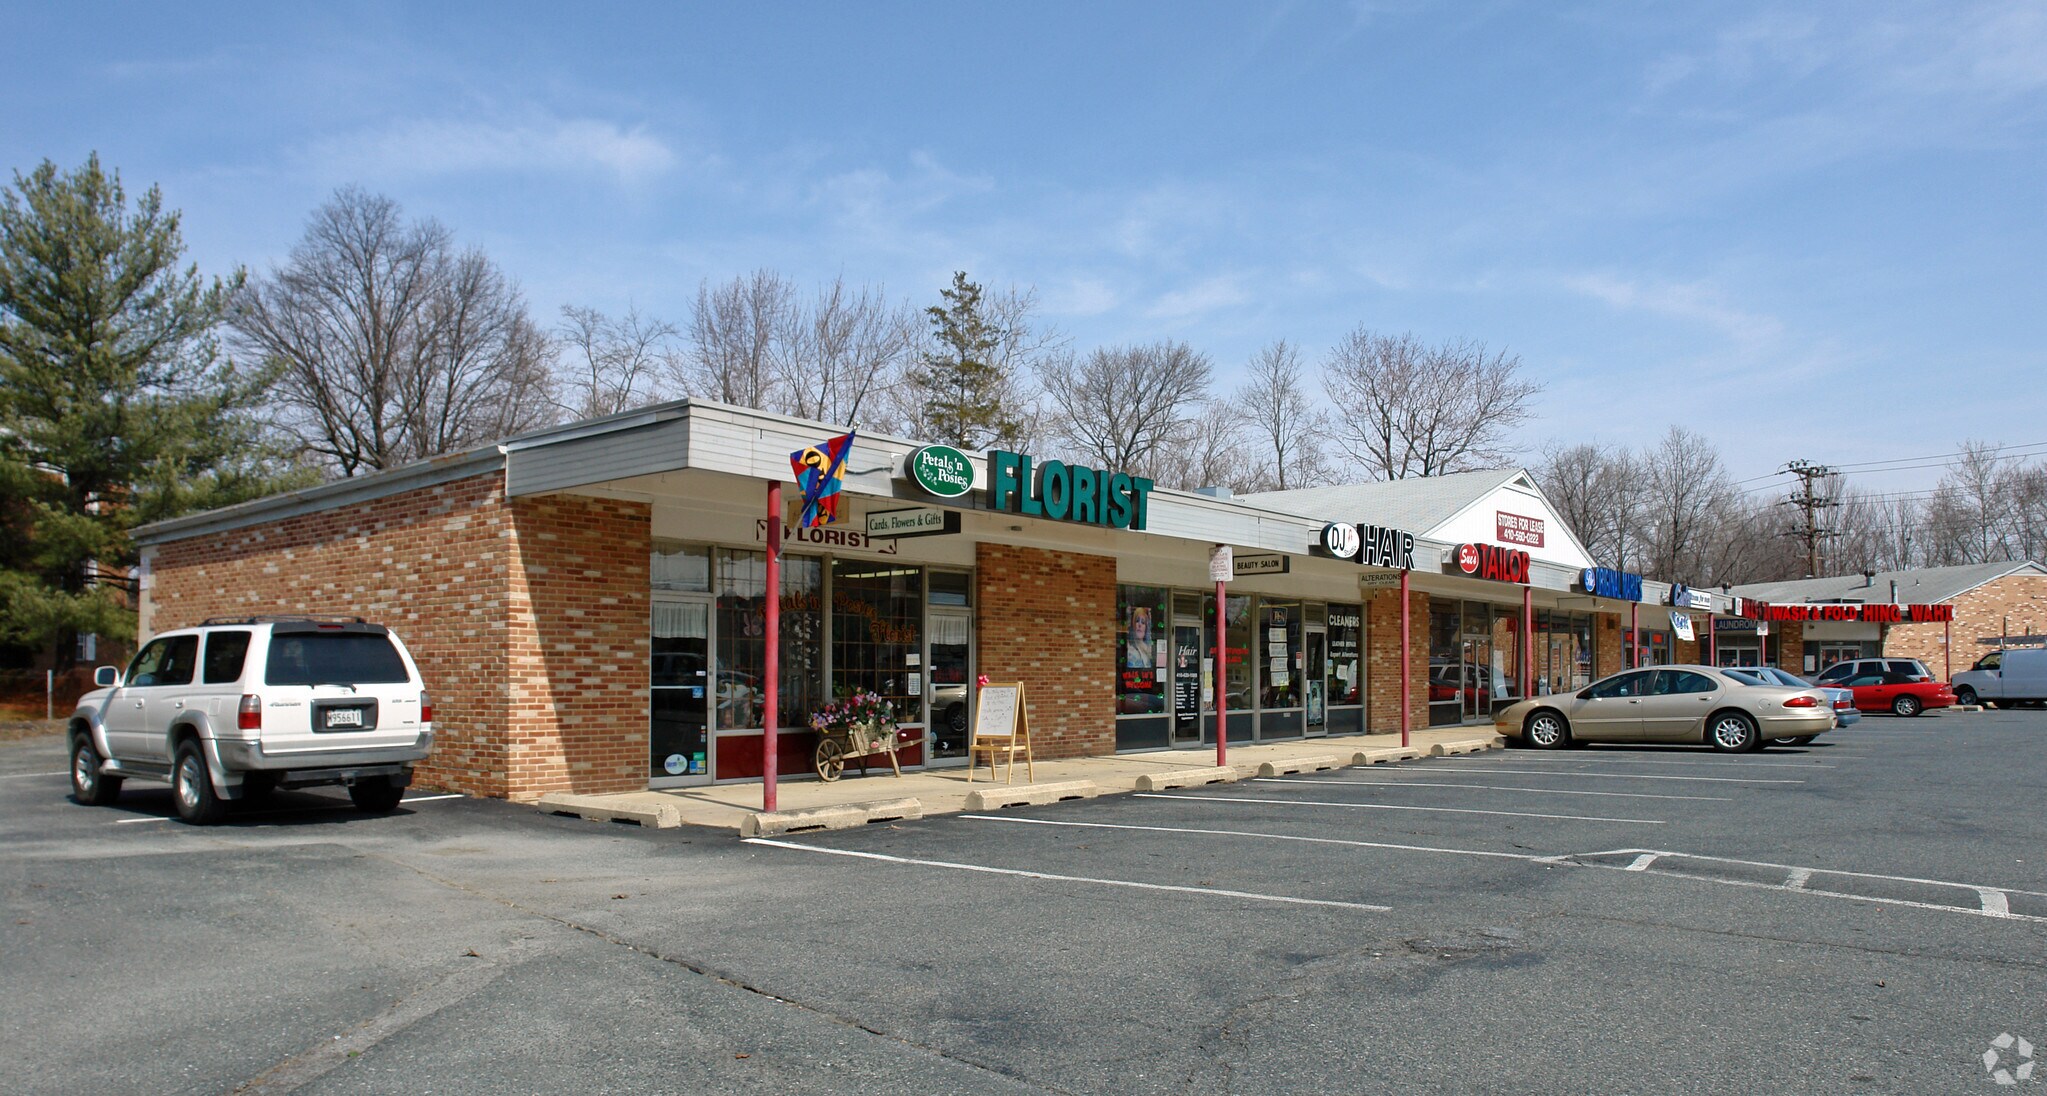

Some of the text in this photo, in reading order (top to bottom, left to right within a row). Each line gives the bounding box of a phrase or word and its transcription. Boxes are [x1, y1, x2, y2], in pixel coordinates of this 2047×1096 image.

[921, 451, 953, 473] Petals
[937, 468, 968, 489] Posies
[988, 450, 1154, 530] FLORIST
[868, 513, 942, 531] Cards, Flowers & Gifts
[1498, 514, 1544, 534] STORES FOR LEASE
[1331, 527, 1346, 551] DJ
[1357, 523, 1417, 571] HAIR
[1237, 560, 1280, 570] BEAUTY SALON
[1460, 548, 1477, 565] Sue's
[1478, 543, 1531, 584] TAILOR
[1361, 573, 1402, 582] ALTERATIONS
[1328, 614, 1359, 628] CLEANERS
[1772, 605, 1808, 621] WASH
[1810, 605, 1820, 620] &
[1823, 606, 1857, 620] FOLD
[1861, 604, 1901, 622] HING
[1908, 604, 1945, 622] WAH
[870, 621, 917, 644] Florist
[1178, 645, 1197, 656] Hair
